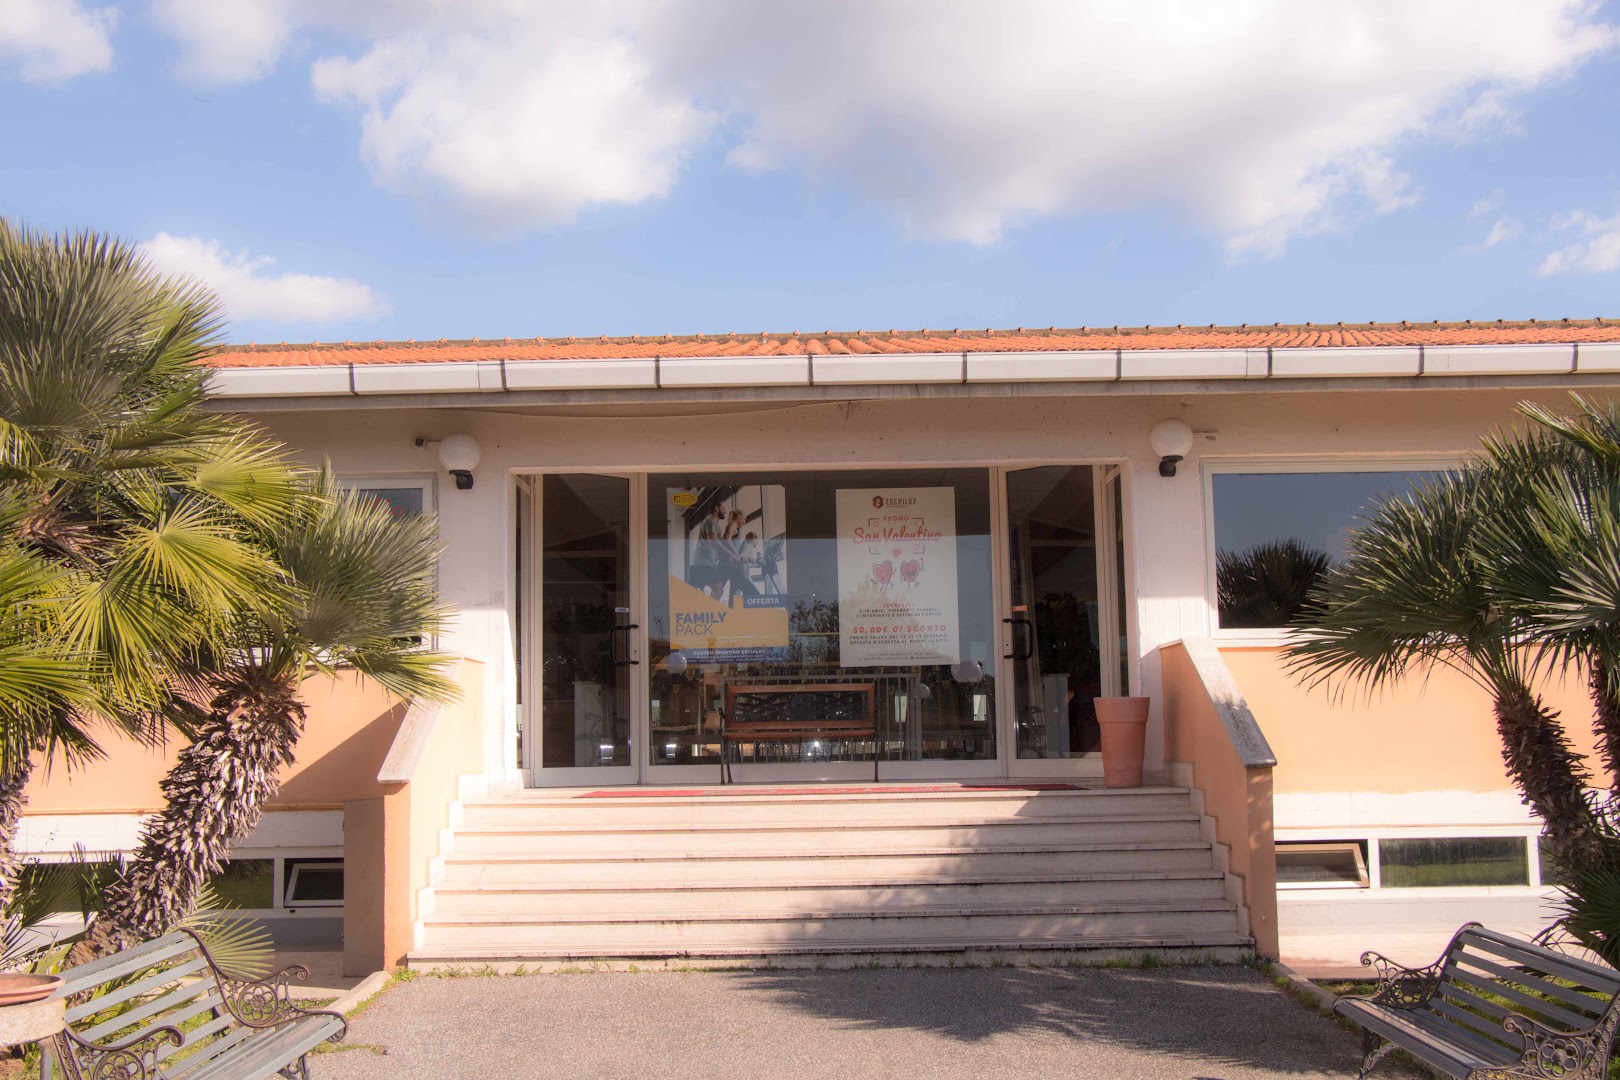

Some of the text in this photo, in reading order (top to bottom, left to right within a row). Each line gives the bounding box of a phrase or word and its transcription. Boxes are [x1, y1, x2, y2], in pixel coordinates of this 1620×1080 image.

[853, 525, 944, 544] San Valentino
[747, 597, 780, 605] OFFERTA
[675, 612, 727, 624] FAMILY
[676, 624, 713, 636] PACK
[852, 625, 889, 634] 50,00€
[907, 624, 947, 632] SCONTO
